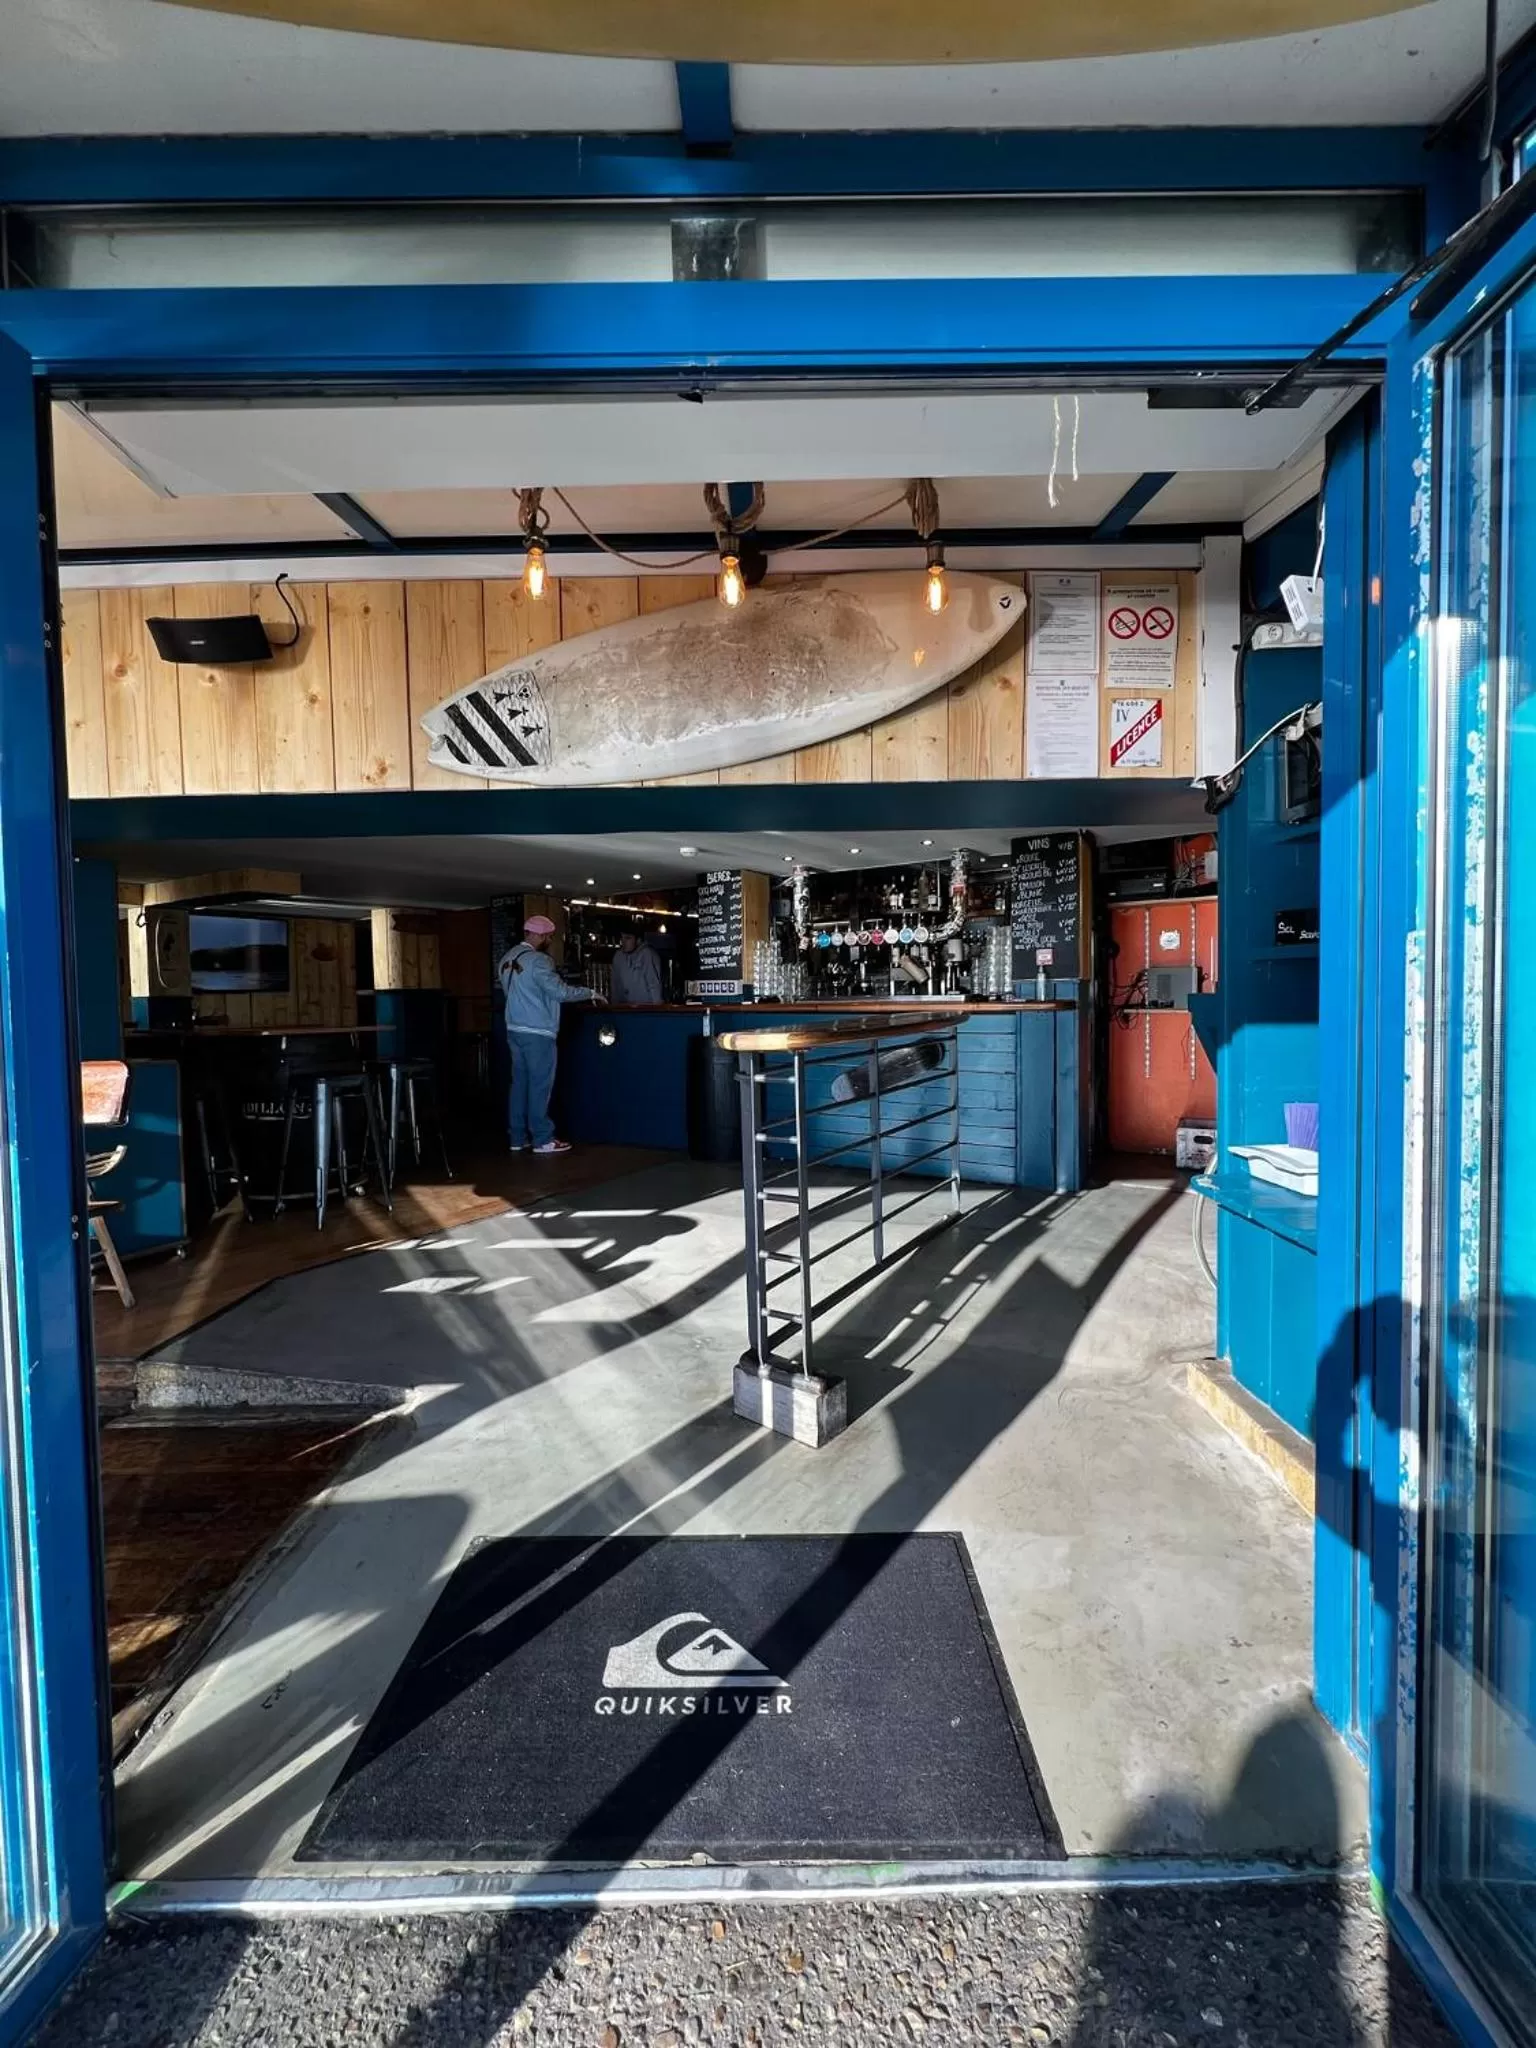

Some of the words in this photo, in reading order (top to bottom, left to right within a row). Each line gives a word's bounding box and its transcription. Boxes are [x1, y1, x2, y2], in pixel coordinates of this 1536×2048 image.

[1117, 708, 1157, 756] LICENCE
[1028, 837, 1050, 850] VINS
[594, 1696, 793, 1716] QUIKSILVER
